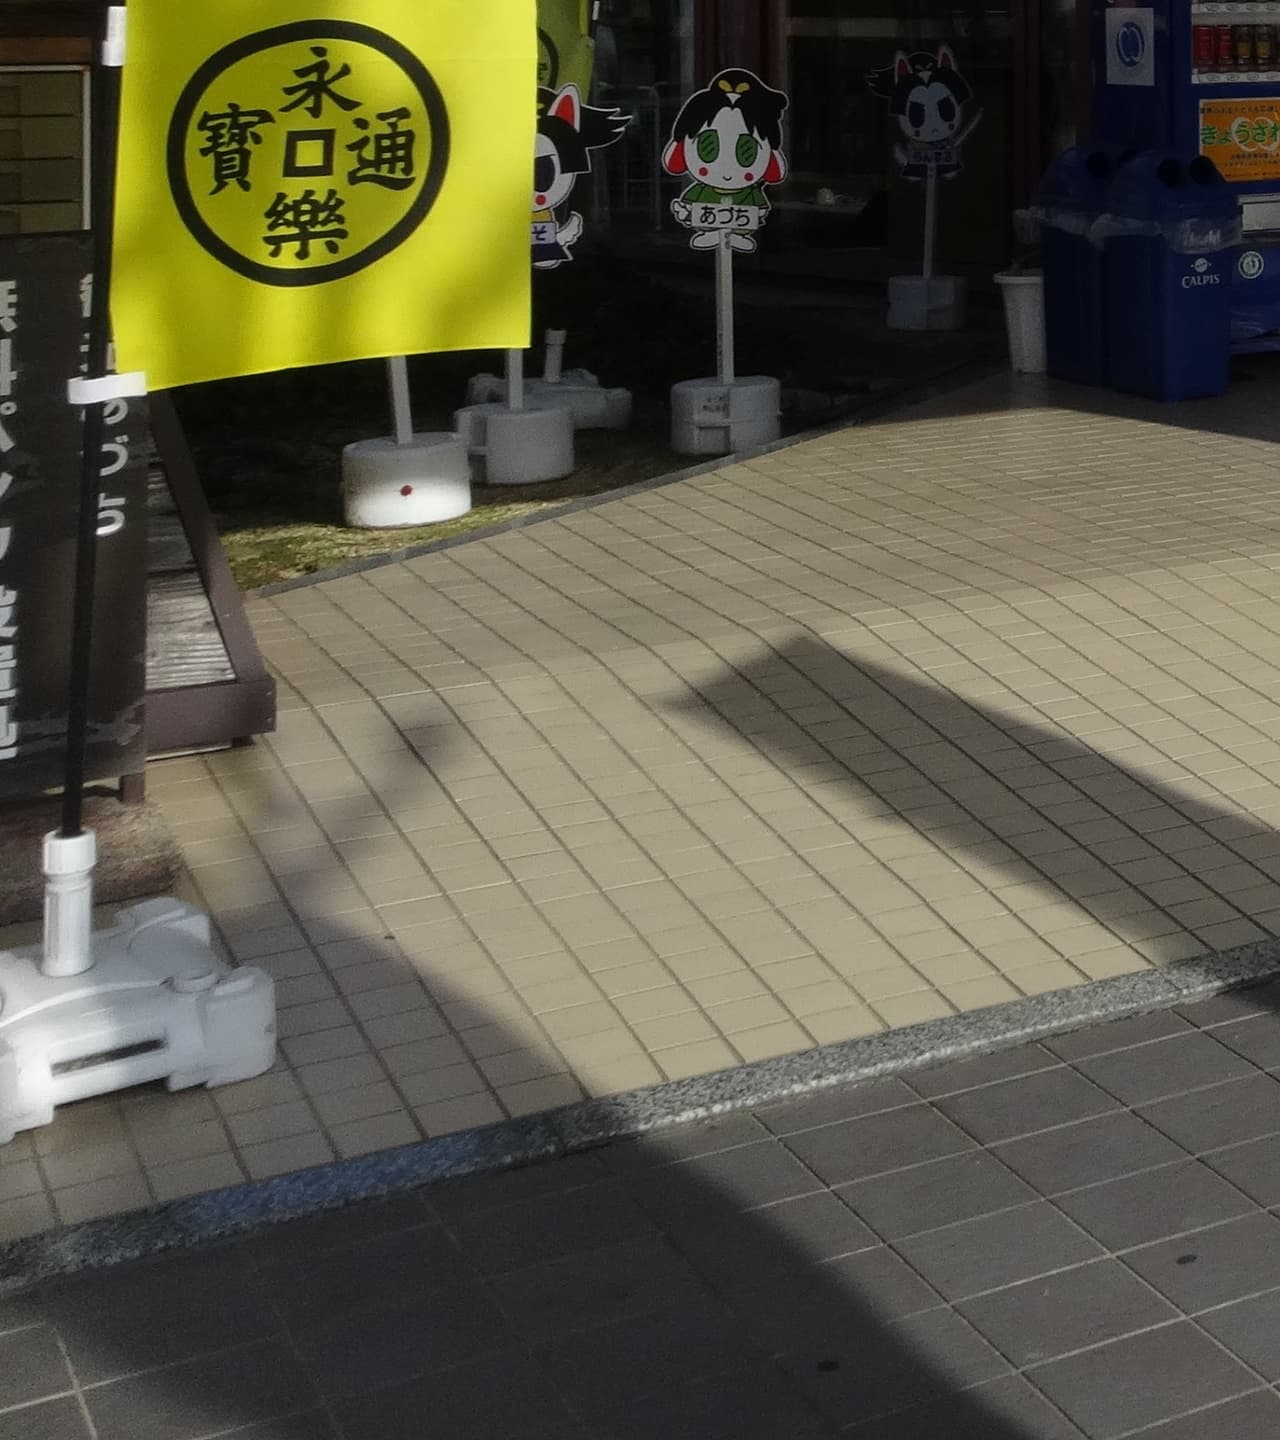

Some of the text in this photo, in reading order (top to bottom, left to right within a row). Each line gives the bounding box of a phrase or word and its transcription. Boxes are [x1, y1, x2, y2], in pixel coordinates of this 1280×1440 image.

[699, 205, 752, 228] あづち
[1181, 273, 1222, 289] CALPIS
